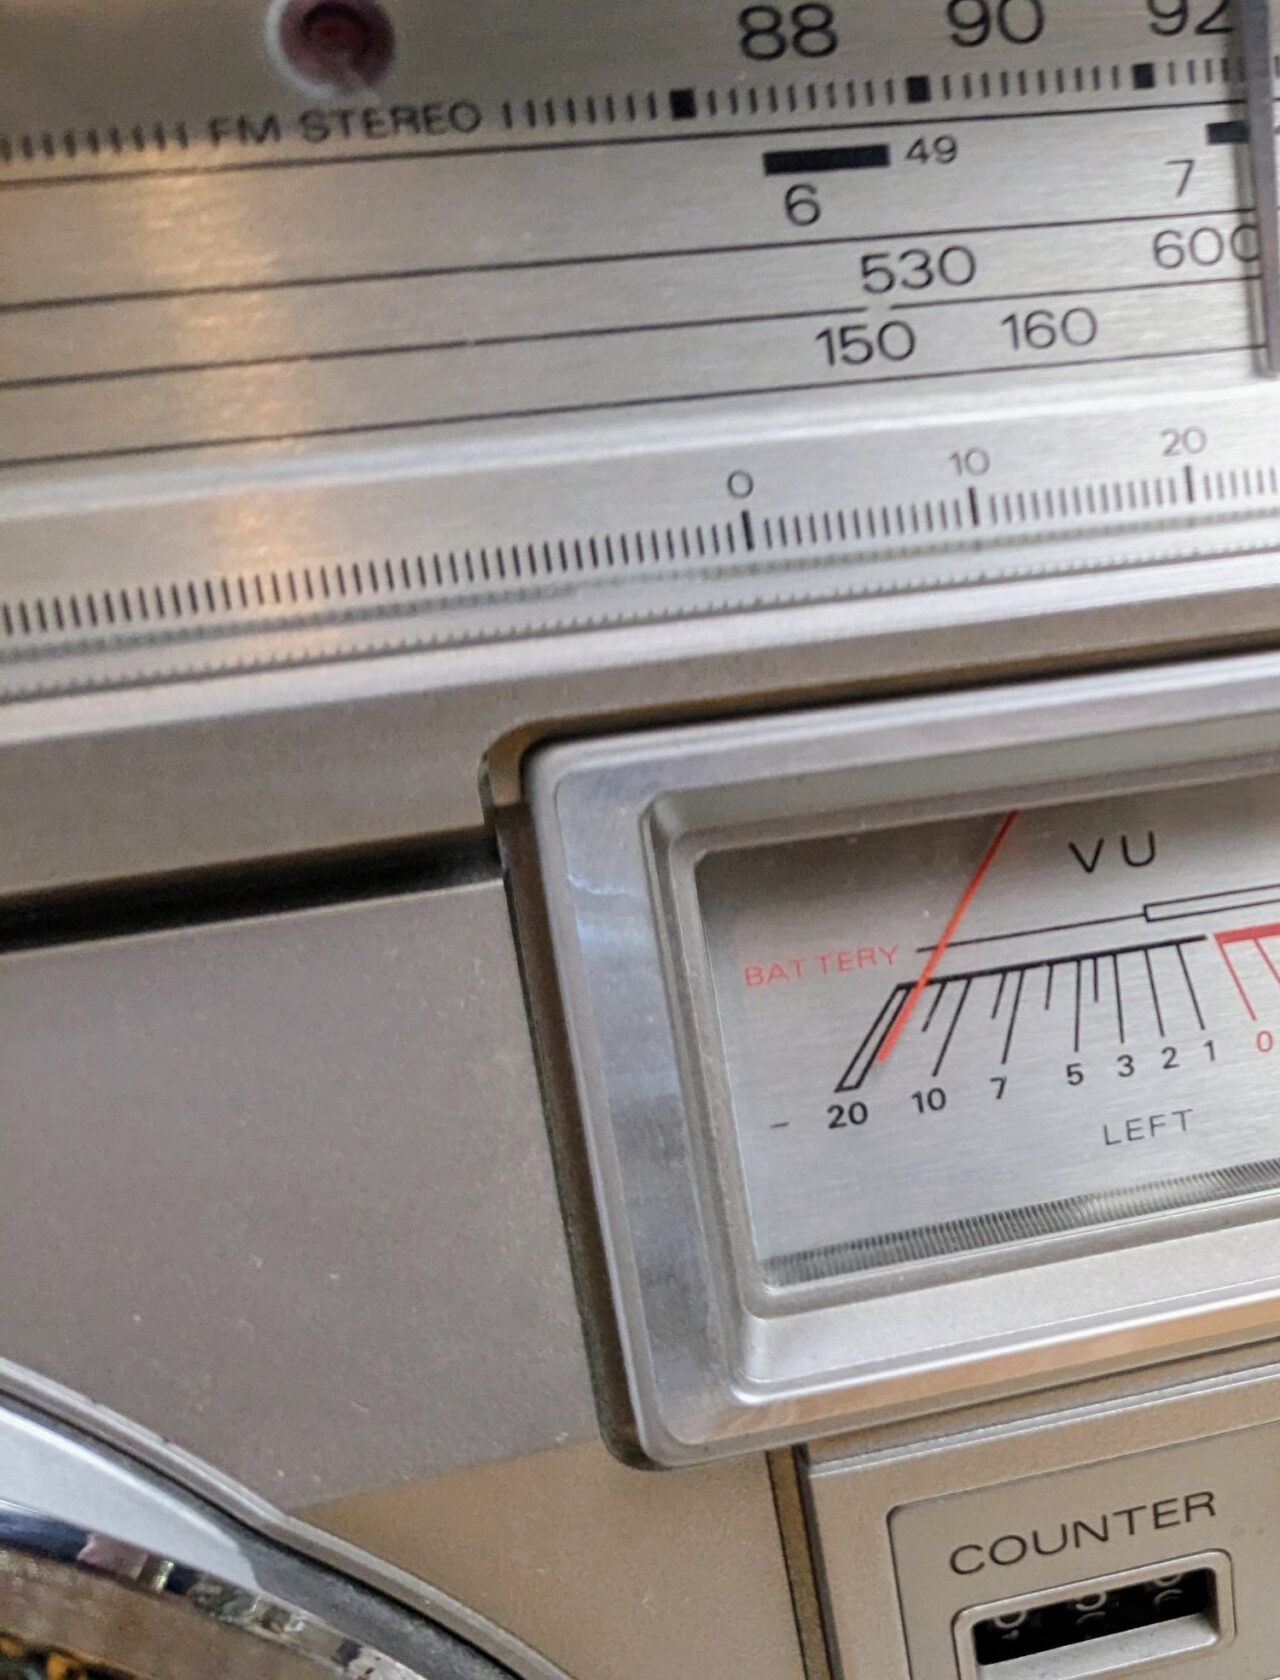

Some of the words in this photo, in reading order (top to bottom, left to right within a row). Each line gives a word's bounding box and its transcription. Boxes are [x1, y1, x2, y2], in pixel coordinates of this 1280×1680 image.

[737, 5, 838, 61] 88
[945, 0, 1044, 48] 90
[211, 115, 281, 146] FM
[300, 101, 481, 140] STEREO
[905, 135, 958, 164] 49
[785, 184, 820, 226] 6
[1165, 159, 1195, 198] 7
[860, 246, 977, 294] 530
[1152, 222, 1262, 269] 600
[815, 320, 916, 366] 150
[1000, 307, 1098, 350] 160
[726, 470, 754, 498] 0
[949, 447, 990, 477] 10
[1160, 426, 1208, 457] 20
[744, 944, 898, 988] BATTERY
[827, 1101, 869, 1130] 20
[911, 1087, 947, 1113] 10
[990, 1077, 1007, 1100] 7
[1066, 1064, 1084, 1086] 5
[1117, 1055, 1135, 1078] 3
[1162, 1047, 1180, 1069] 2
[1204, 1039, 1217, 1062] 1
[1256, 1031, 1274, 1053] 0
[1103, 1108, 1194, 1146] LEFT
[948, 1491, 1216, 1575] COUNTER
